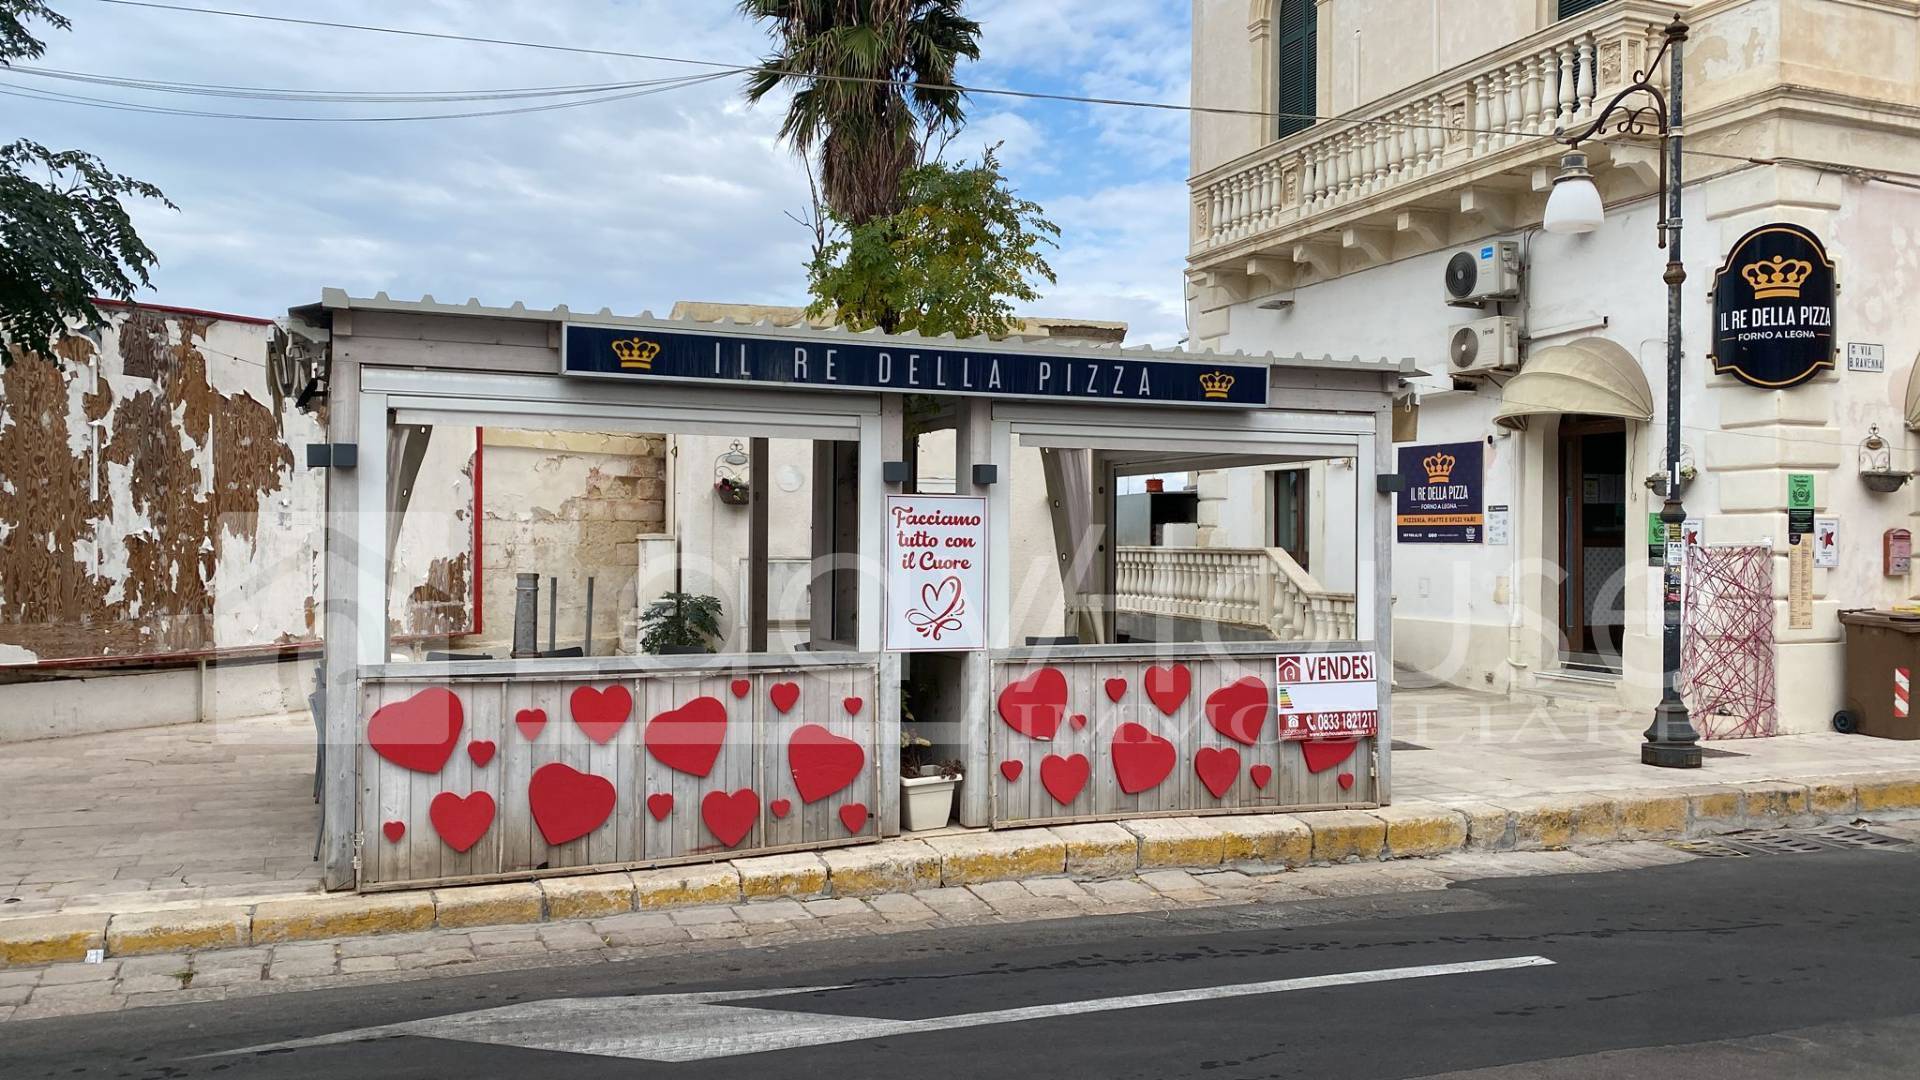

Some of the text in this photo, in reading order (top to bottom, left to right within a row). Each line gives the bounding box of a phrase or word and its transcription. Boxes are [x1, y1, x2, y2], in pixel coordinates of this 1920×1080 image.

[1720, 305, 1831, 331] IL RE DELLA PIZZA
[1738, 330, 1815, 341] FORNO A LEGNA
[1860, 345, 1872, 356] VIA
[714, 341, 1152, 397] IL RE DELLA PIZZA
[1411, 485, 1468, 501] IL RE DELLA PIZZA
[891, 506, 981, 528] Facciamo
[897, 530, 976, 548] tutto con
[902, 551, 972, 571] il Cuore
[1305, 656, 1373, 680] VENDESI
[1318, 711, 1377, 730] 0833 1821211
